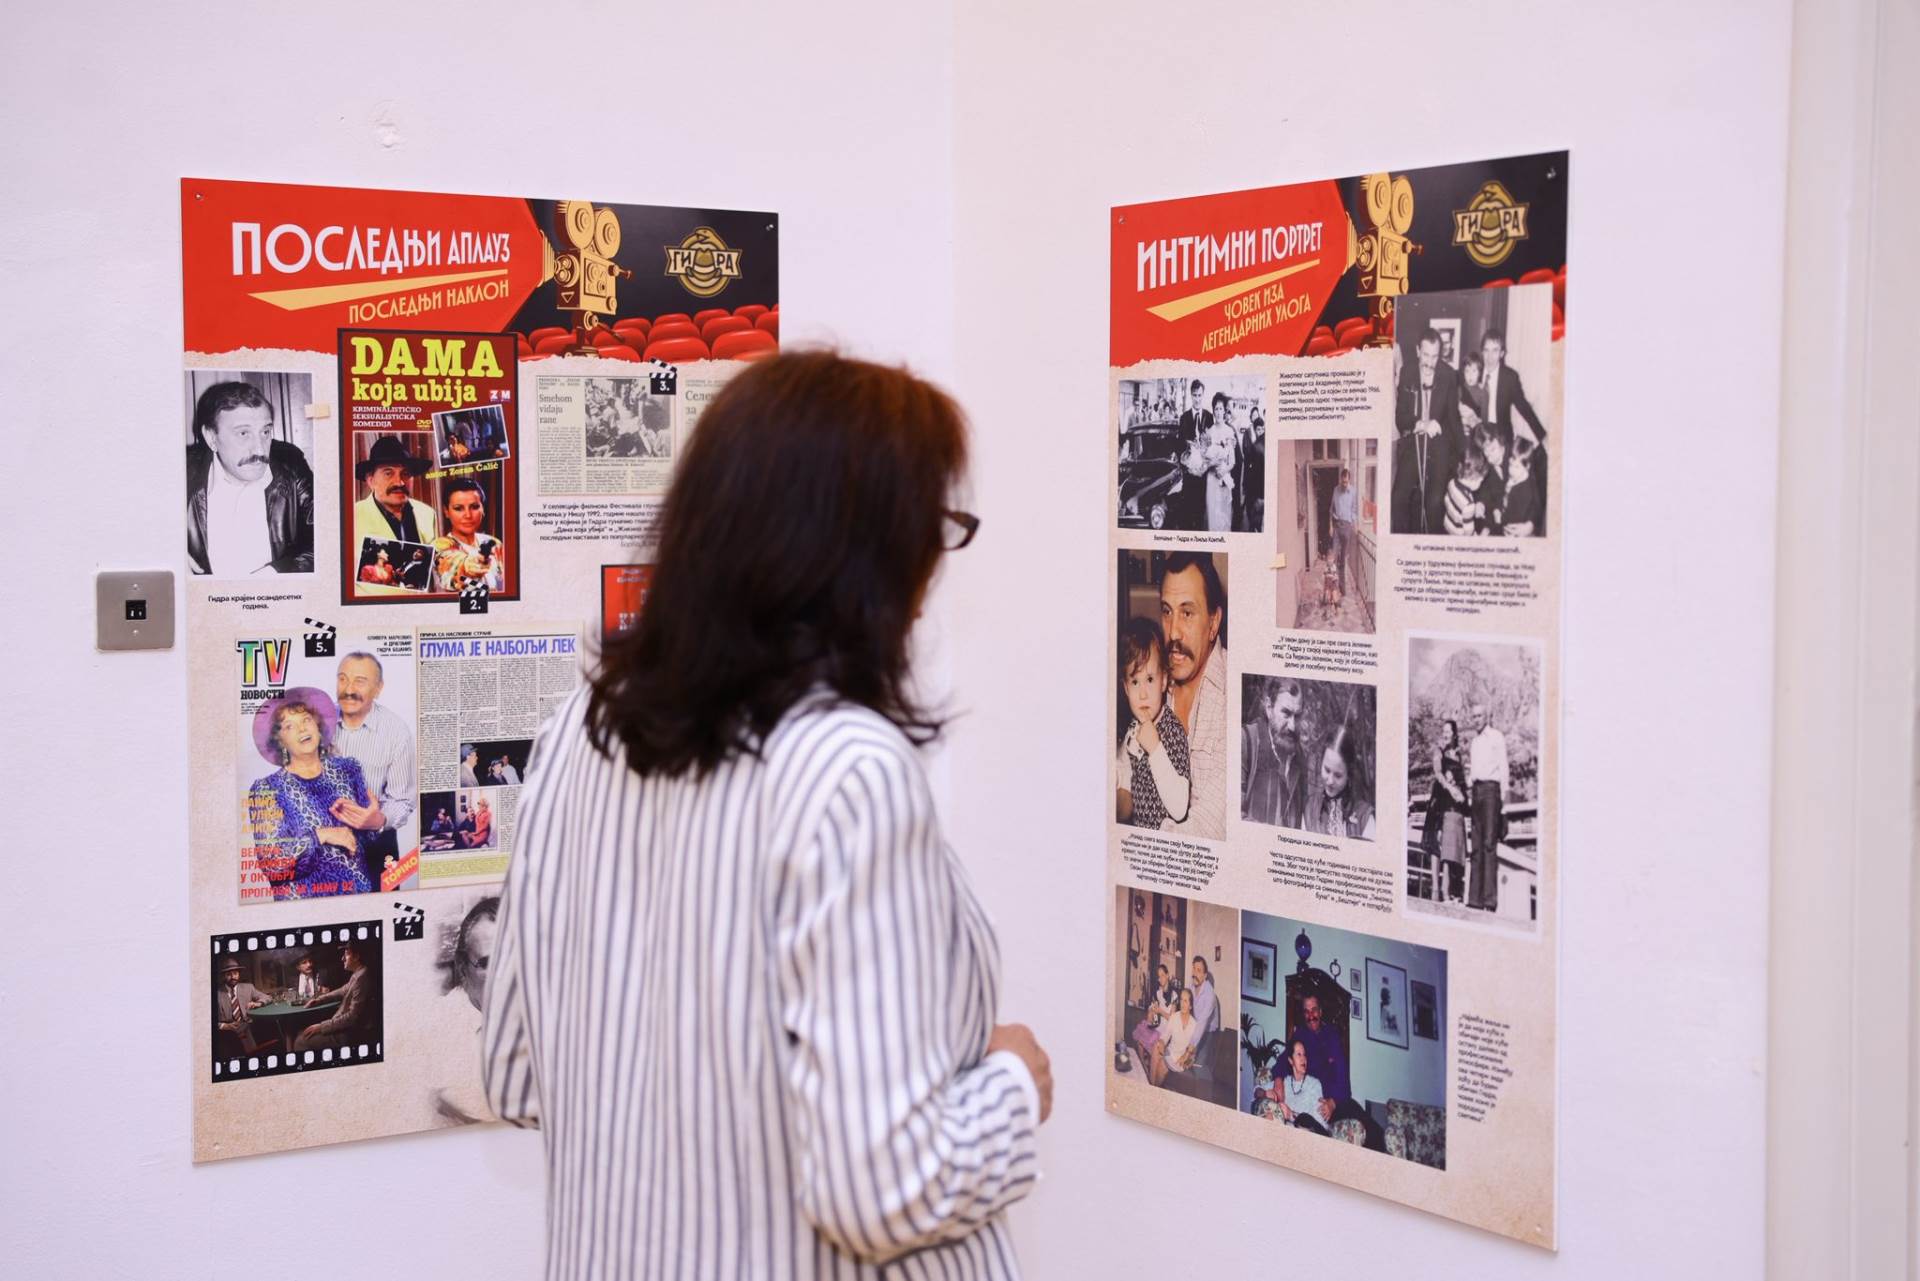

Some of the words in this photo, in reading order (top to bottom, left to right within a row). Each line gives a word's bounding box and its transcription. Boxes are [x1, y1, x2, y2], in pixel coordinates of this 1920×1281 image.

[232, 222, 441, 275] ПОСЛЕДЊИ
[447, 231, 511, 265] АПЛАУЗ
[1137, 229, 1256, 292] ИНТИМНИ
[1262, 222, 1323, 263] ПОРТРЕТ
[349, 292, 442, 324] ПОСЛЕДЊИ
[447, 279, 509, 306] НАКЛОН
[1224, 291, 1261, 321] ЧОВЕК
[1263, 281, 1285, 306] ИЗА
[1202, 309, 1272, 353] ЛЕГЕНДАРНИХ
[1276, 293, 1311, 323] УЛОГА
[350, 336, 504, 378] DAMA
[352, 377, 408, 407] koja
[412, 378, 478, 408] ubija
[659, 381, 670, 392] 3.
[539, 394, 572, 403] Smehom
[539, 404, 563, 414] vidaju
[352, 420, 392, 428] KOMEDIJA
[449, 467, 474, 478] Zoran
[470, 600, 481, 610] 2.
[316, 642, 328, 653] 5.
[419, 641, 465, 658] ГЛУМА
[469, 640, 481, 656] ЈЕ
[486, 639, 548, 656] НАЈБОЉИ
[551, 638, 576, 654] ЛЕК
[236, 638, 292, 687] TV
[240, 689, 285, 700] НОВОСТИ
[404, 925, 414, 936] 7.
